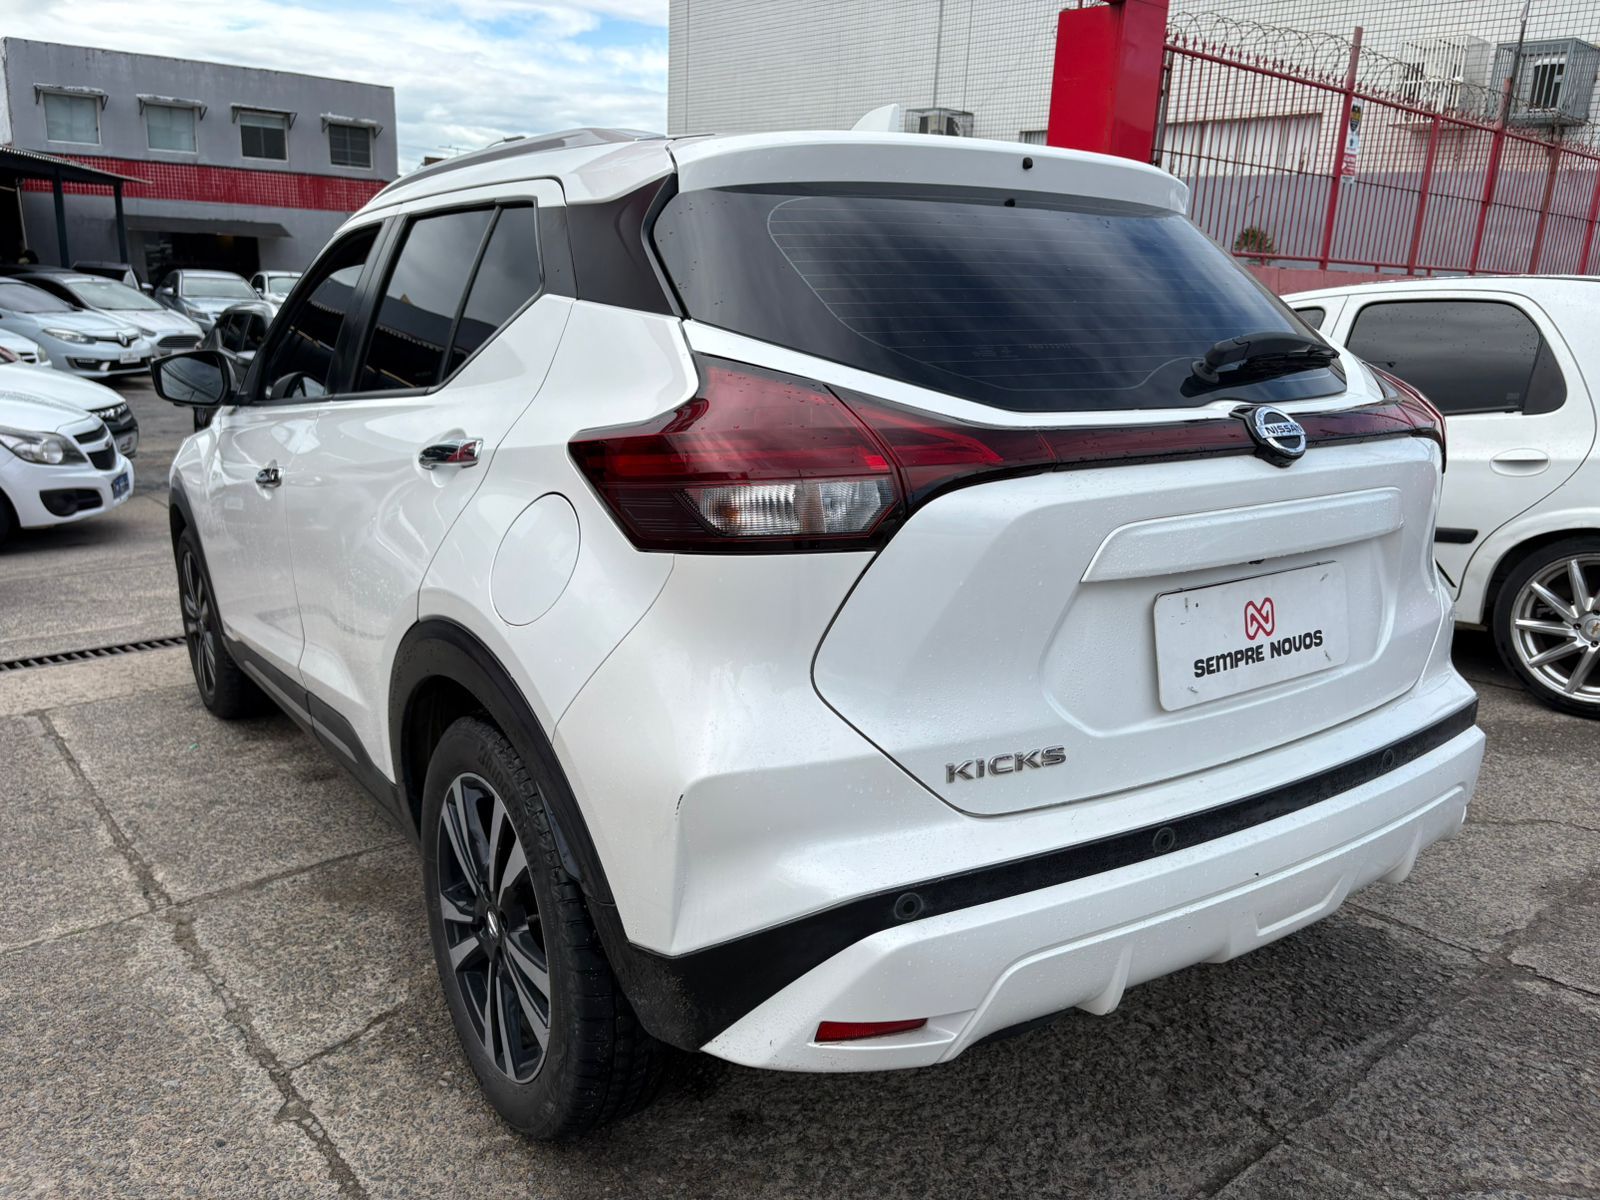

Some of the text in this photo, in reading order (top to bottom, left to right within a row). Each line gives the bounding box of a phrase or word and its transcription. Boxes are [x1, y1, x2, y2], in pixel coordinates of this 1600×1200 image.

[1264, 423, 1303, 435] NISSAN
[1193, 629, 1323, 678] SEMPRE NOVOS
[945, 744, 1067, 784] KICKS
